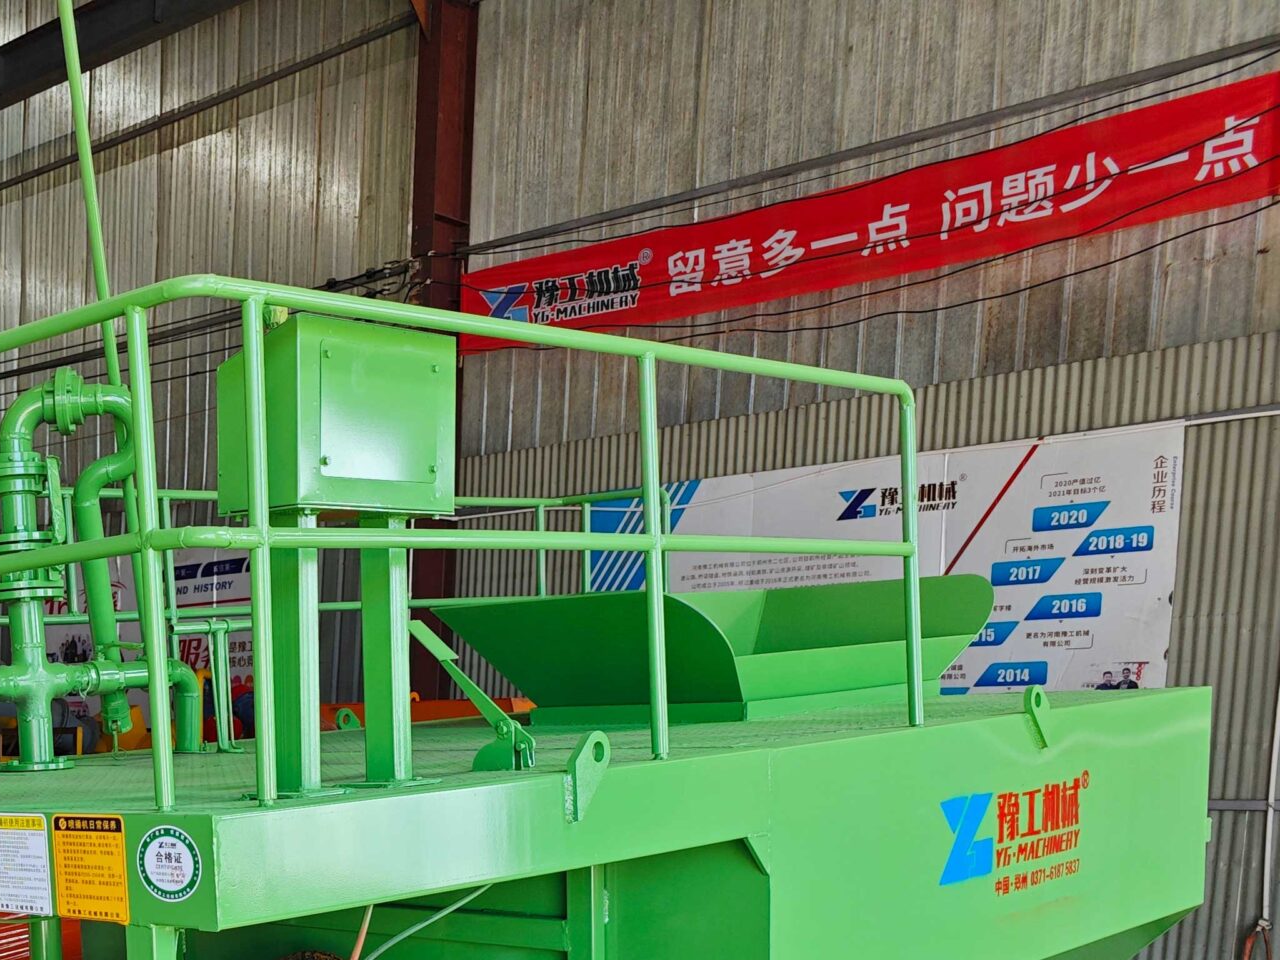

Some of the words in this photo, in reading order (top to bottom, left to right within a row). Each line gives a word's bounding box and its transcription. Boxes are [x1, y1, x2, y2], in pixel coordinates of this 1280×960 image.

[666, 202, 910, 297] 留意多一点
[939, 115, 1261, 241] 问题少一点
[532, 261, 641, 310] 豫工机械
[1054, 476, 1102, 488] 2020产值过亿
[1151, 455, 1169, 514] 企业历程
[880, 481, 958, 507] 豫机械
[1048, 485, 1107, 498] 2021年目标3个亿
[1050, 509, 1088, 526] 2020
[1012, 543, 1055, 554] 开拓海外市场
[1088, 532, 1148, 551] 2018-19
[1009, 565, 1041, 582] 2017
[176, 585, 189, 595] ND
[193, 579, 234, 594] HISTORY
[1051, 598, 1087, 614] 2016
[1026, 629, 1090, 640] 更名为河南豫工机械
[1043, 640, 1071, 648] 有限公司
[997, 668, 1030, 682] 2014
[155, 851, 183, 864] 合格证
